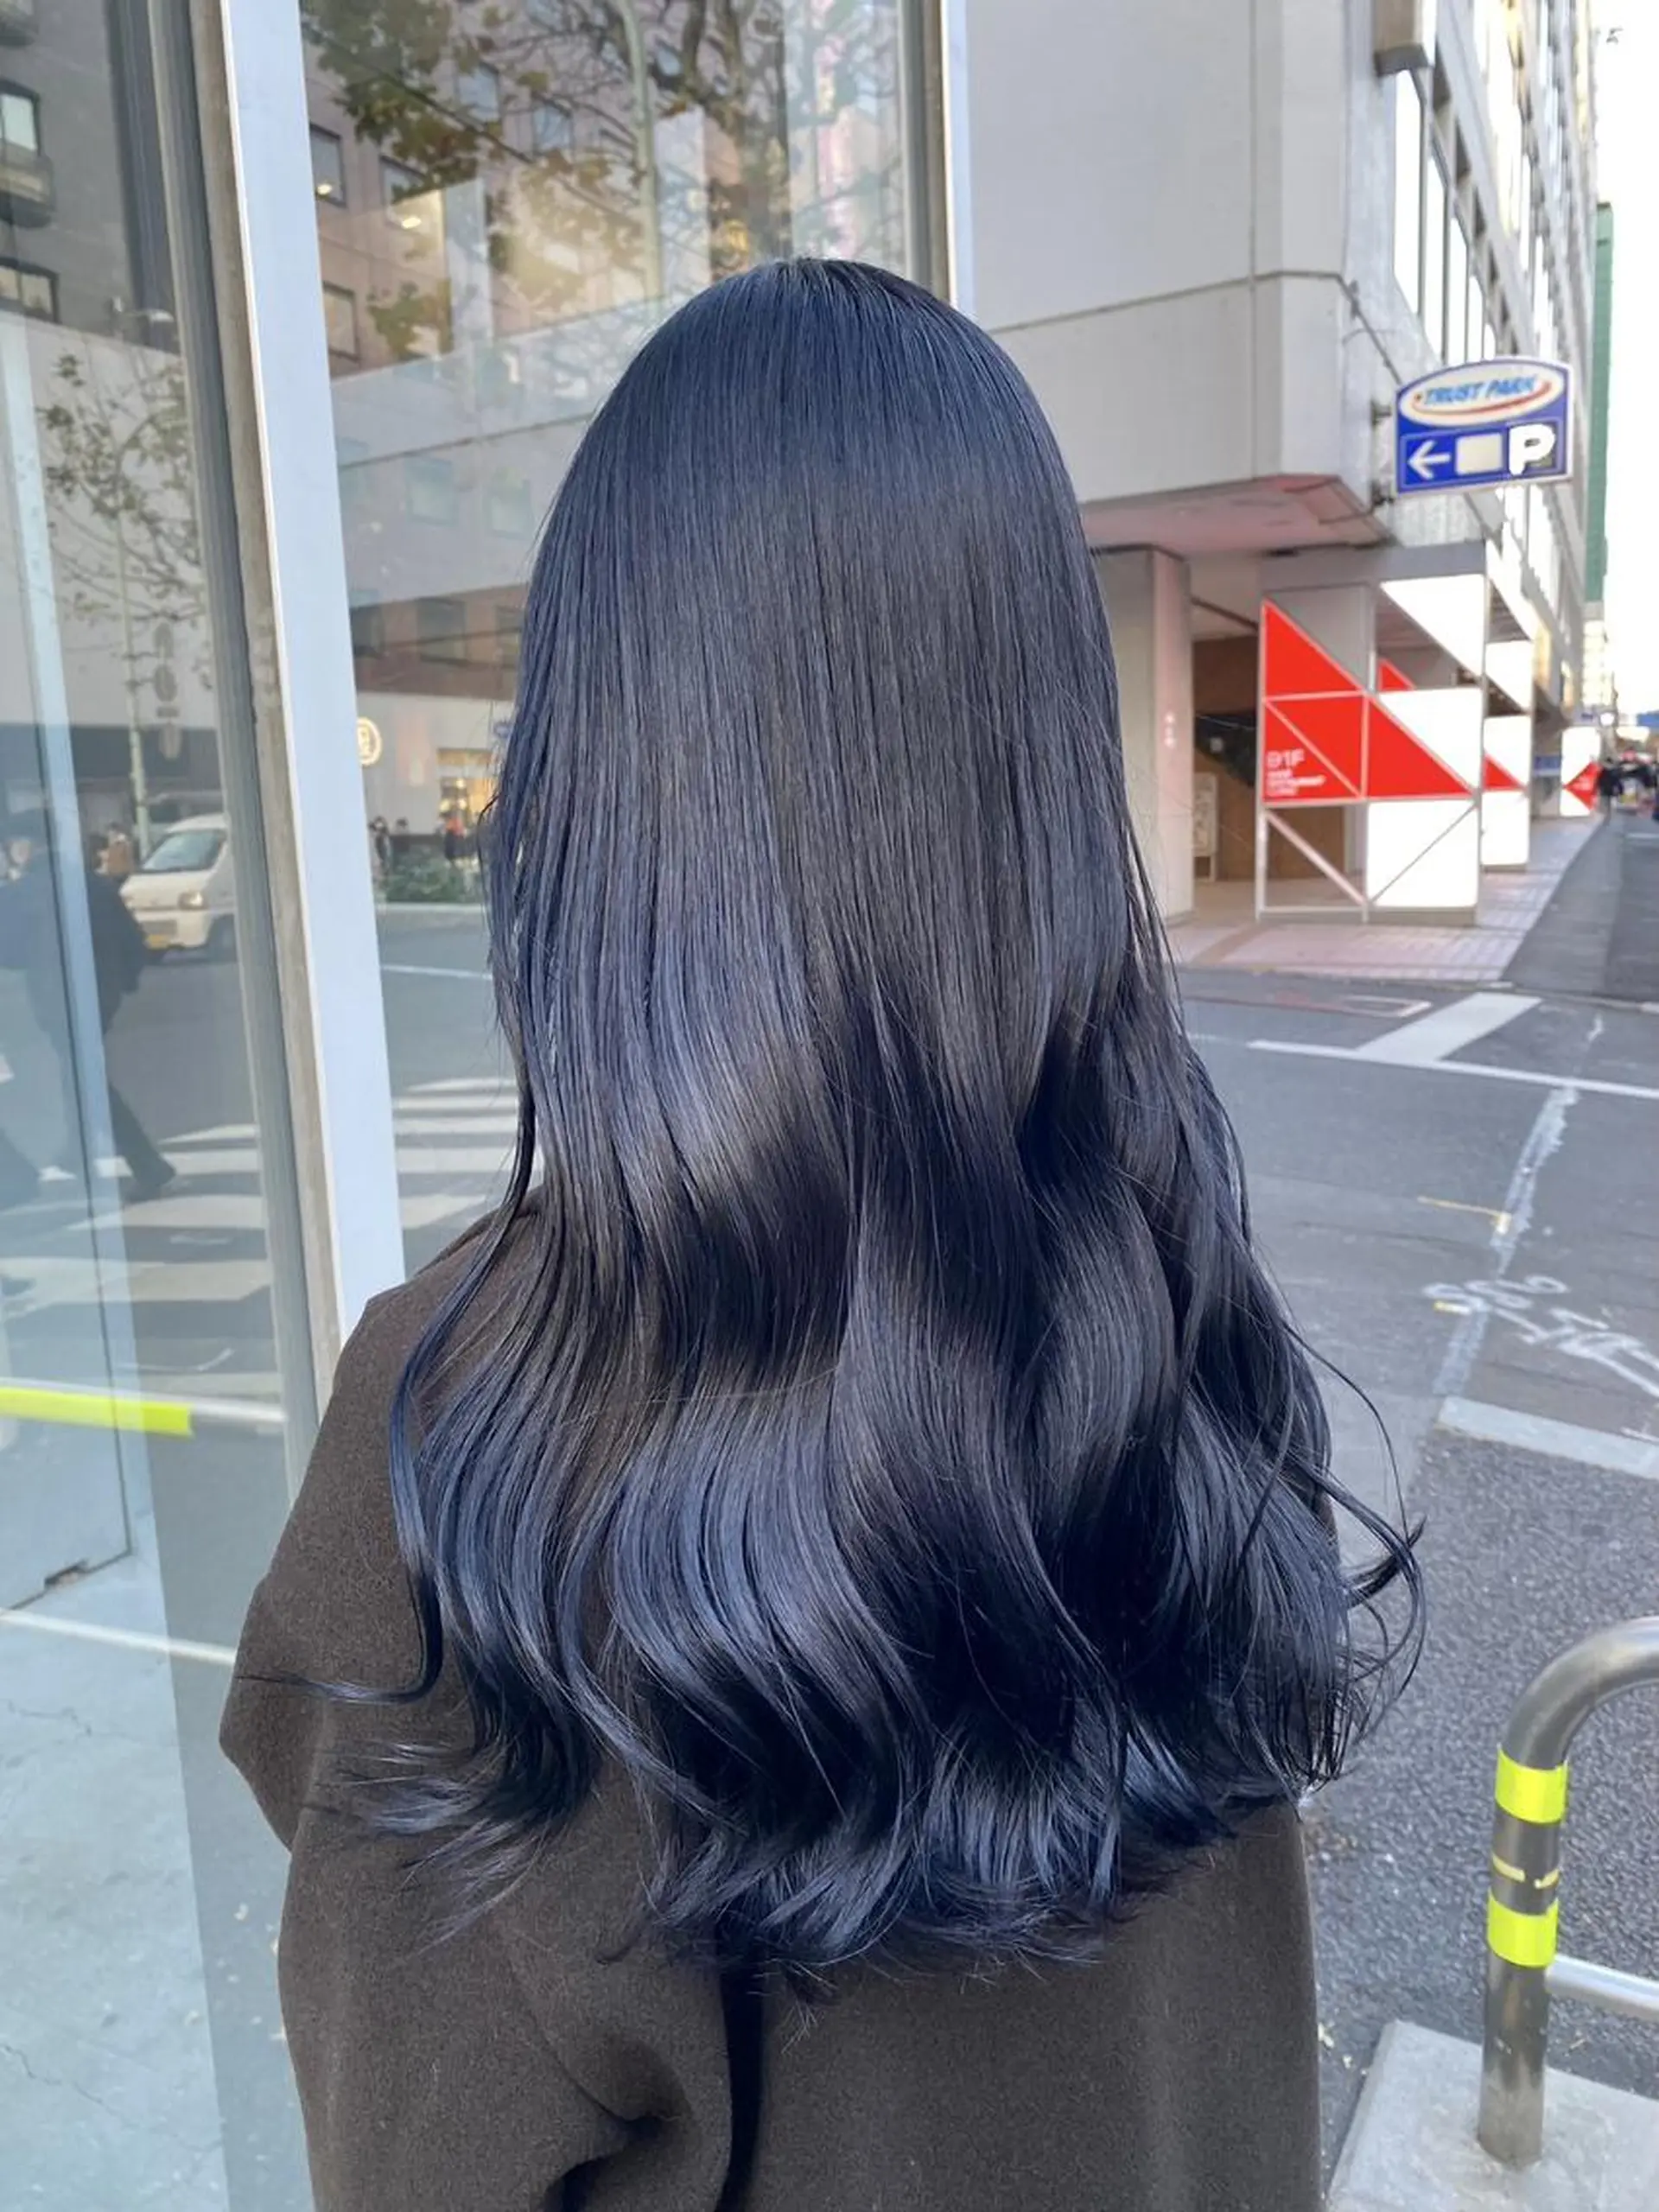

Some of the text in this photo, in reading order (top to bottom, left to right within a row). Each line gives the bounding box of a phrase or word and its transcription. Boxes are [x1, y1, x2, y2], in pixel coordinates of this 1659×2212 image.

[1426, 375, 1537, 404] TRUST PARK
[1509, 423, 1555, 475] P
